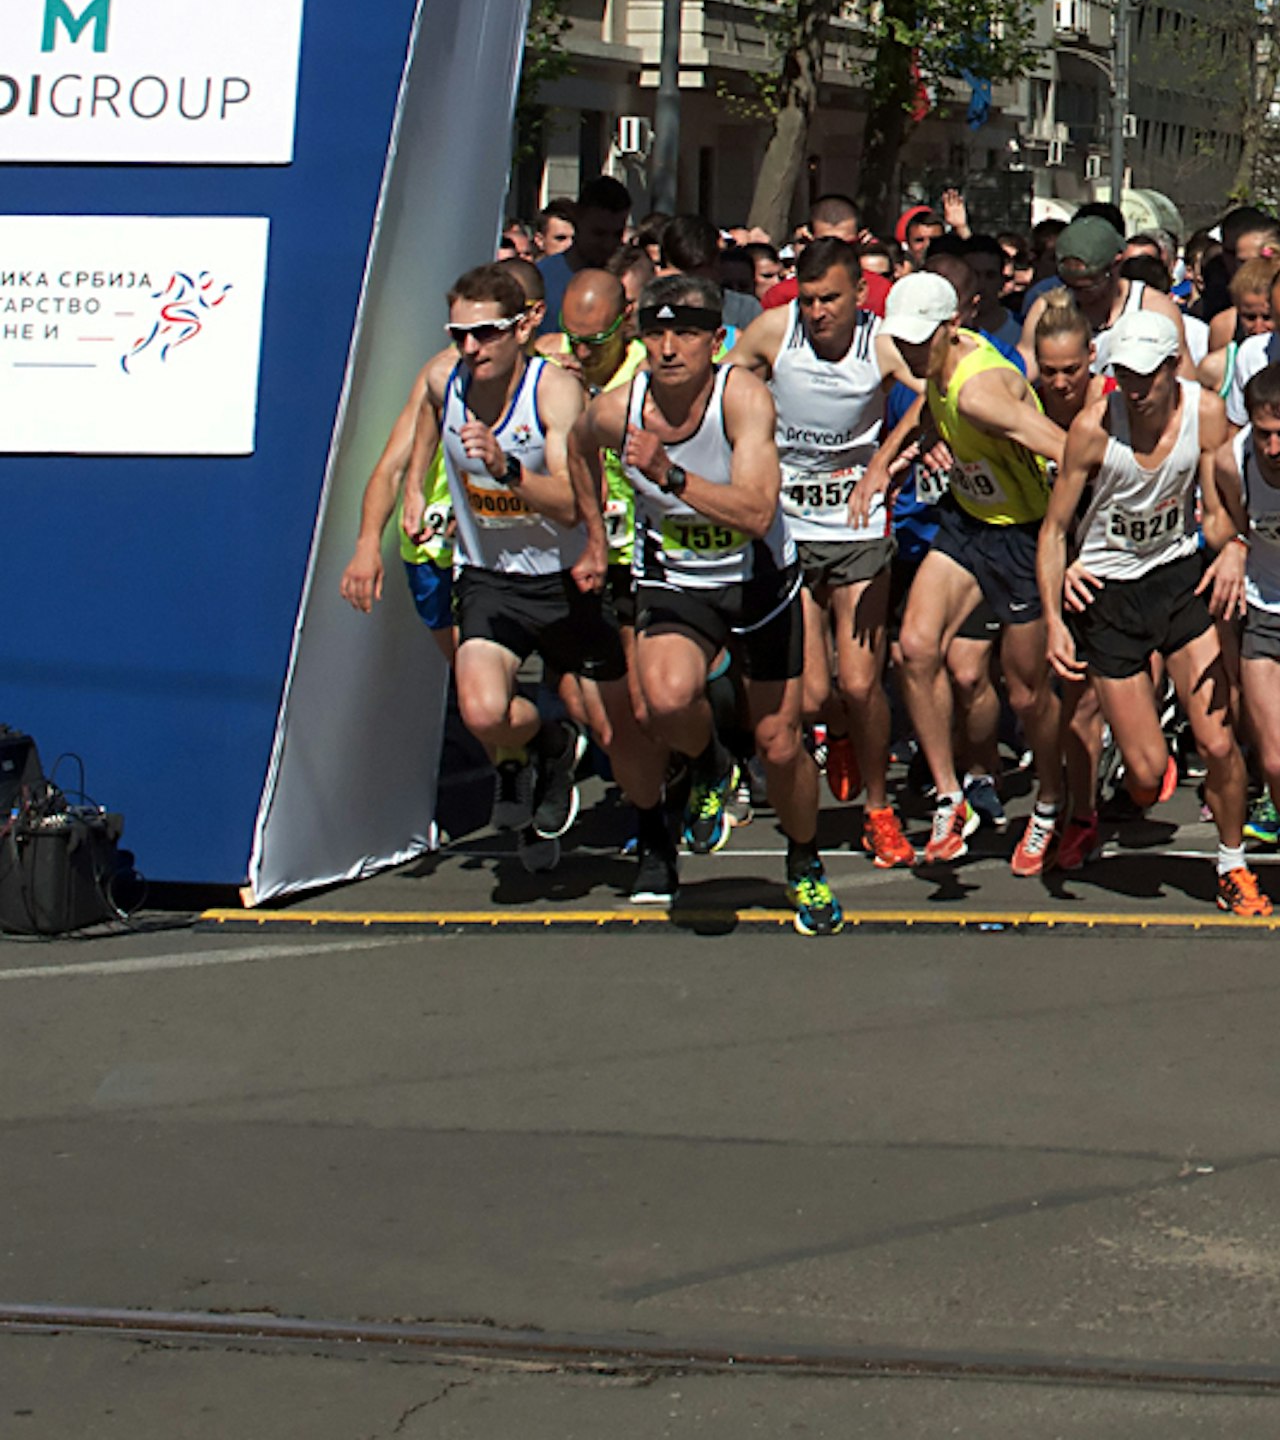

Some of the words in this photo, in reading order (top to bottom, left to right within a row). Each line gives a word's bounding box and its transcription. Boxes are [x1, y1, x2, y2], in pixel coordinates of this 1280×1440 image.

[58, 271, 152, 288] СРБИЈА
[0, 297, 101, 314] АРСТВО
[44, 324, 59, 340] И
[1111, 506, 1179, 542] 5820
[674, 524, 733, 549] 755
